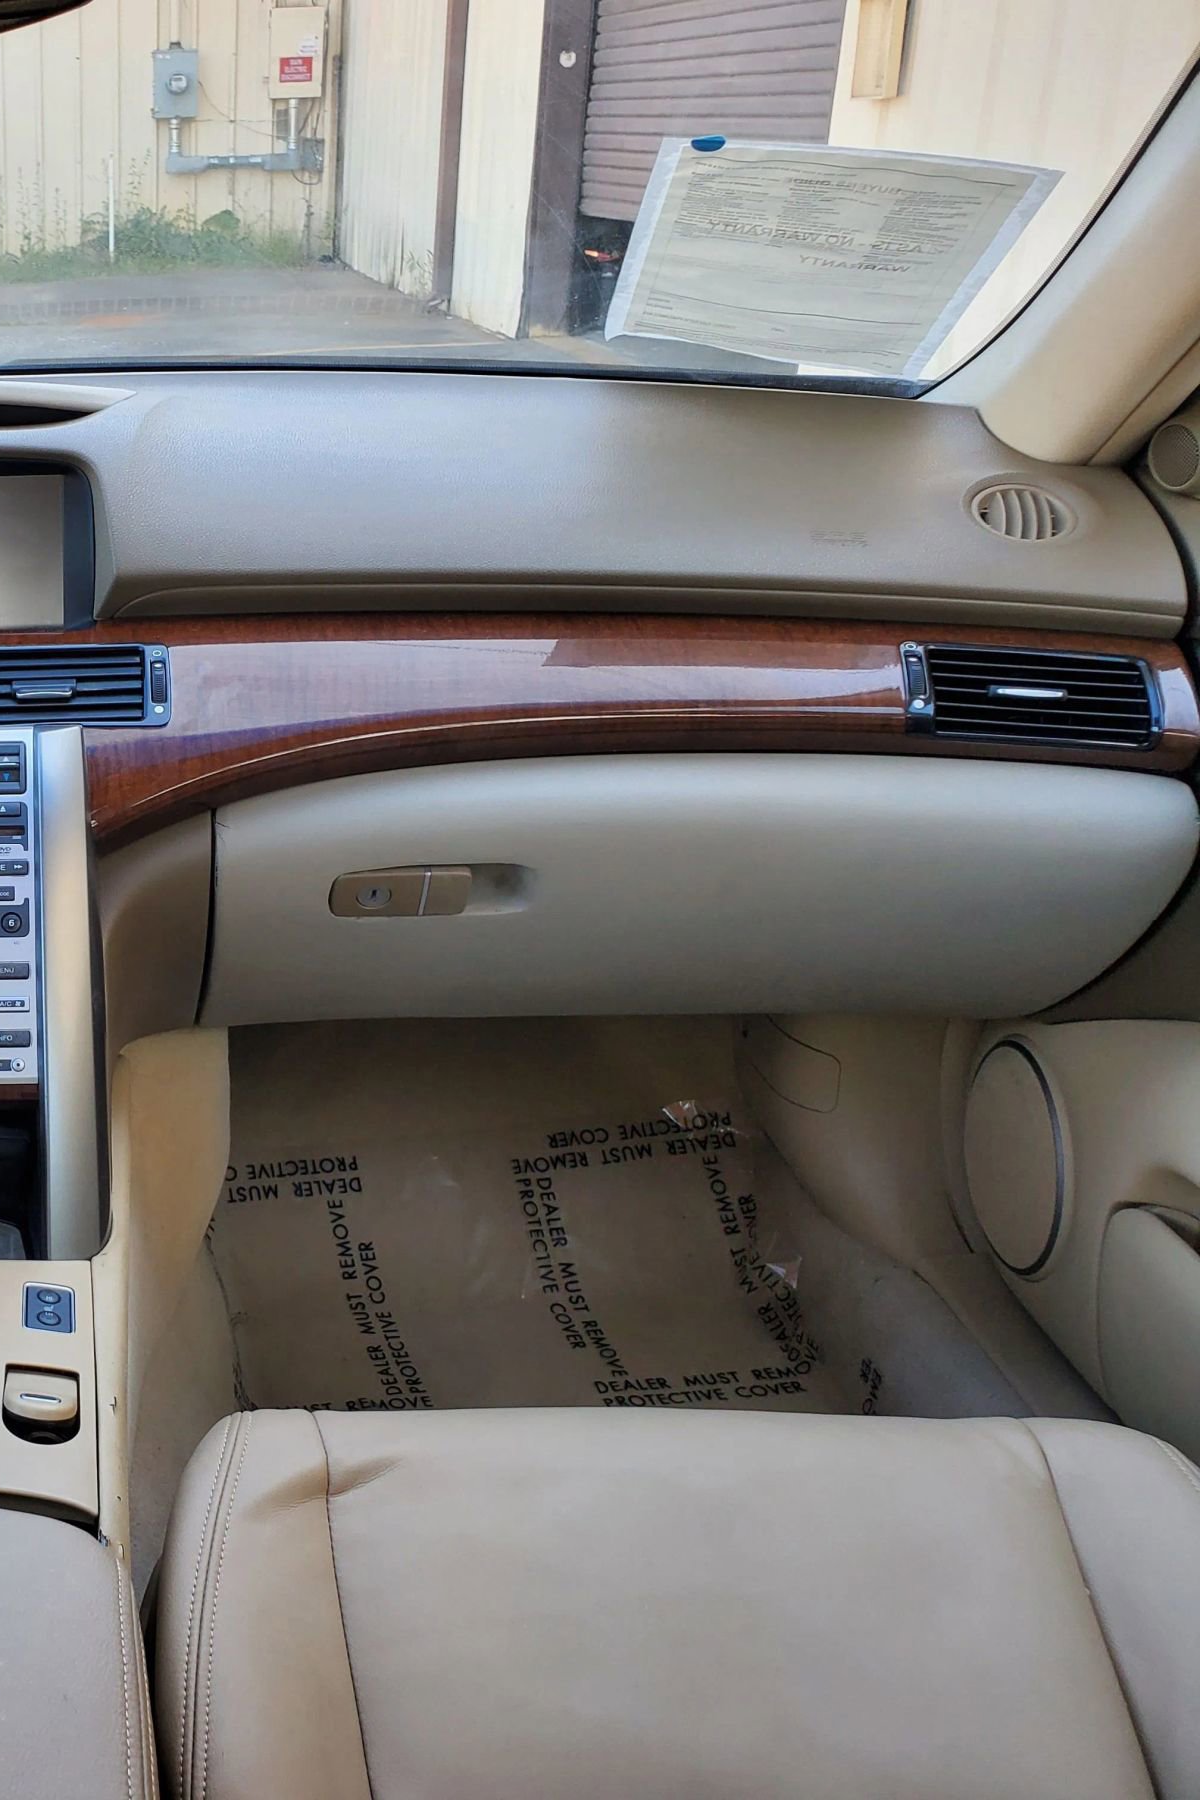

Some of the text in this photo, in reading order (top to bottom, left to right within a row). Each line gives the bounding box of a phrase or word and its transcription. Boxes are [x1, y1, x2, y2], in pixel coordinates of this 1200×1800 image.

[8, 919, 15, 927] 6
[512, 1132, 737, 1175] DEALER MUST REMOVE
[547, 1111, 732, 1149] PROTECTIVE COVER
[227, 1177, 362, 1204] DEALER MUST
[246, 1155, 359, 1180] PROTECTIVE
[703, 1154, 742, 1237] REMOVE
[516, 1178, 587, 1350] PROTECTIVE COVER
[536, 1177, 629, 1378] DEALER MUST REMOVE
[730, 1247, 759, 1295] MUST
[327, 1200, 404, 1397] DEALER MUST REMOVE
[358, 1241, 427, 1394] PROTECTIVE COVER
[593, 1336, 821, 1395] DEALER MUST REMOVE
[602, 1381, 809, 1408] PROTECTIVE COVER
